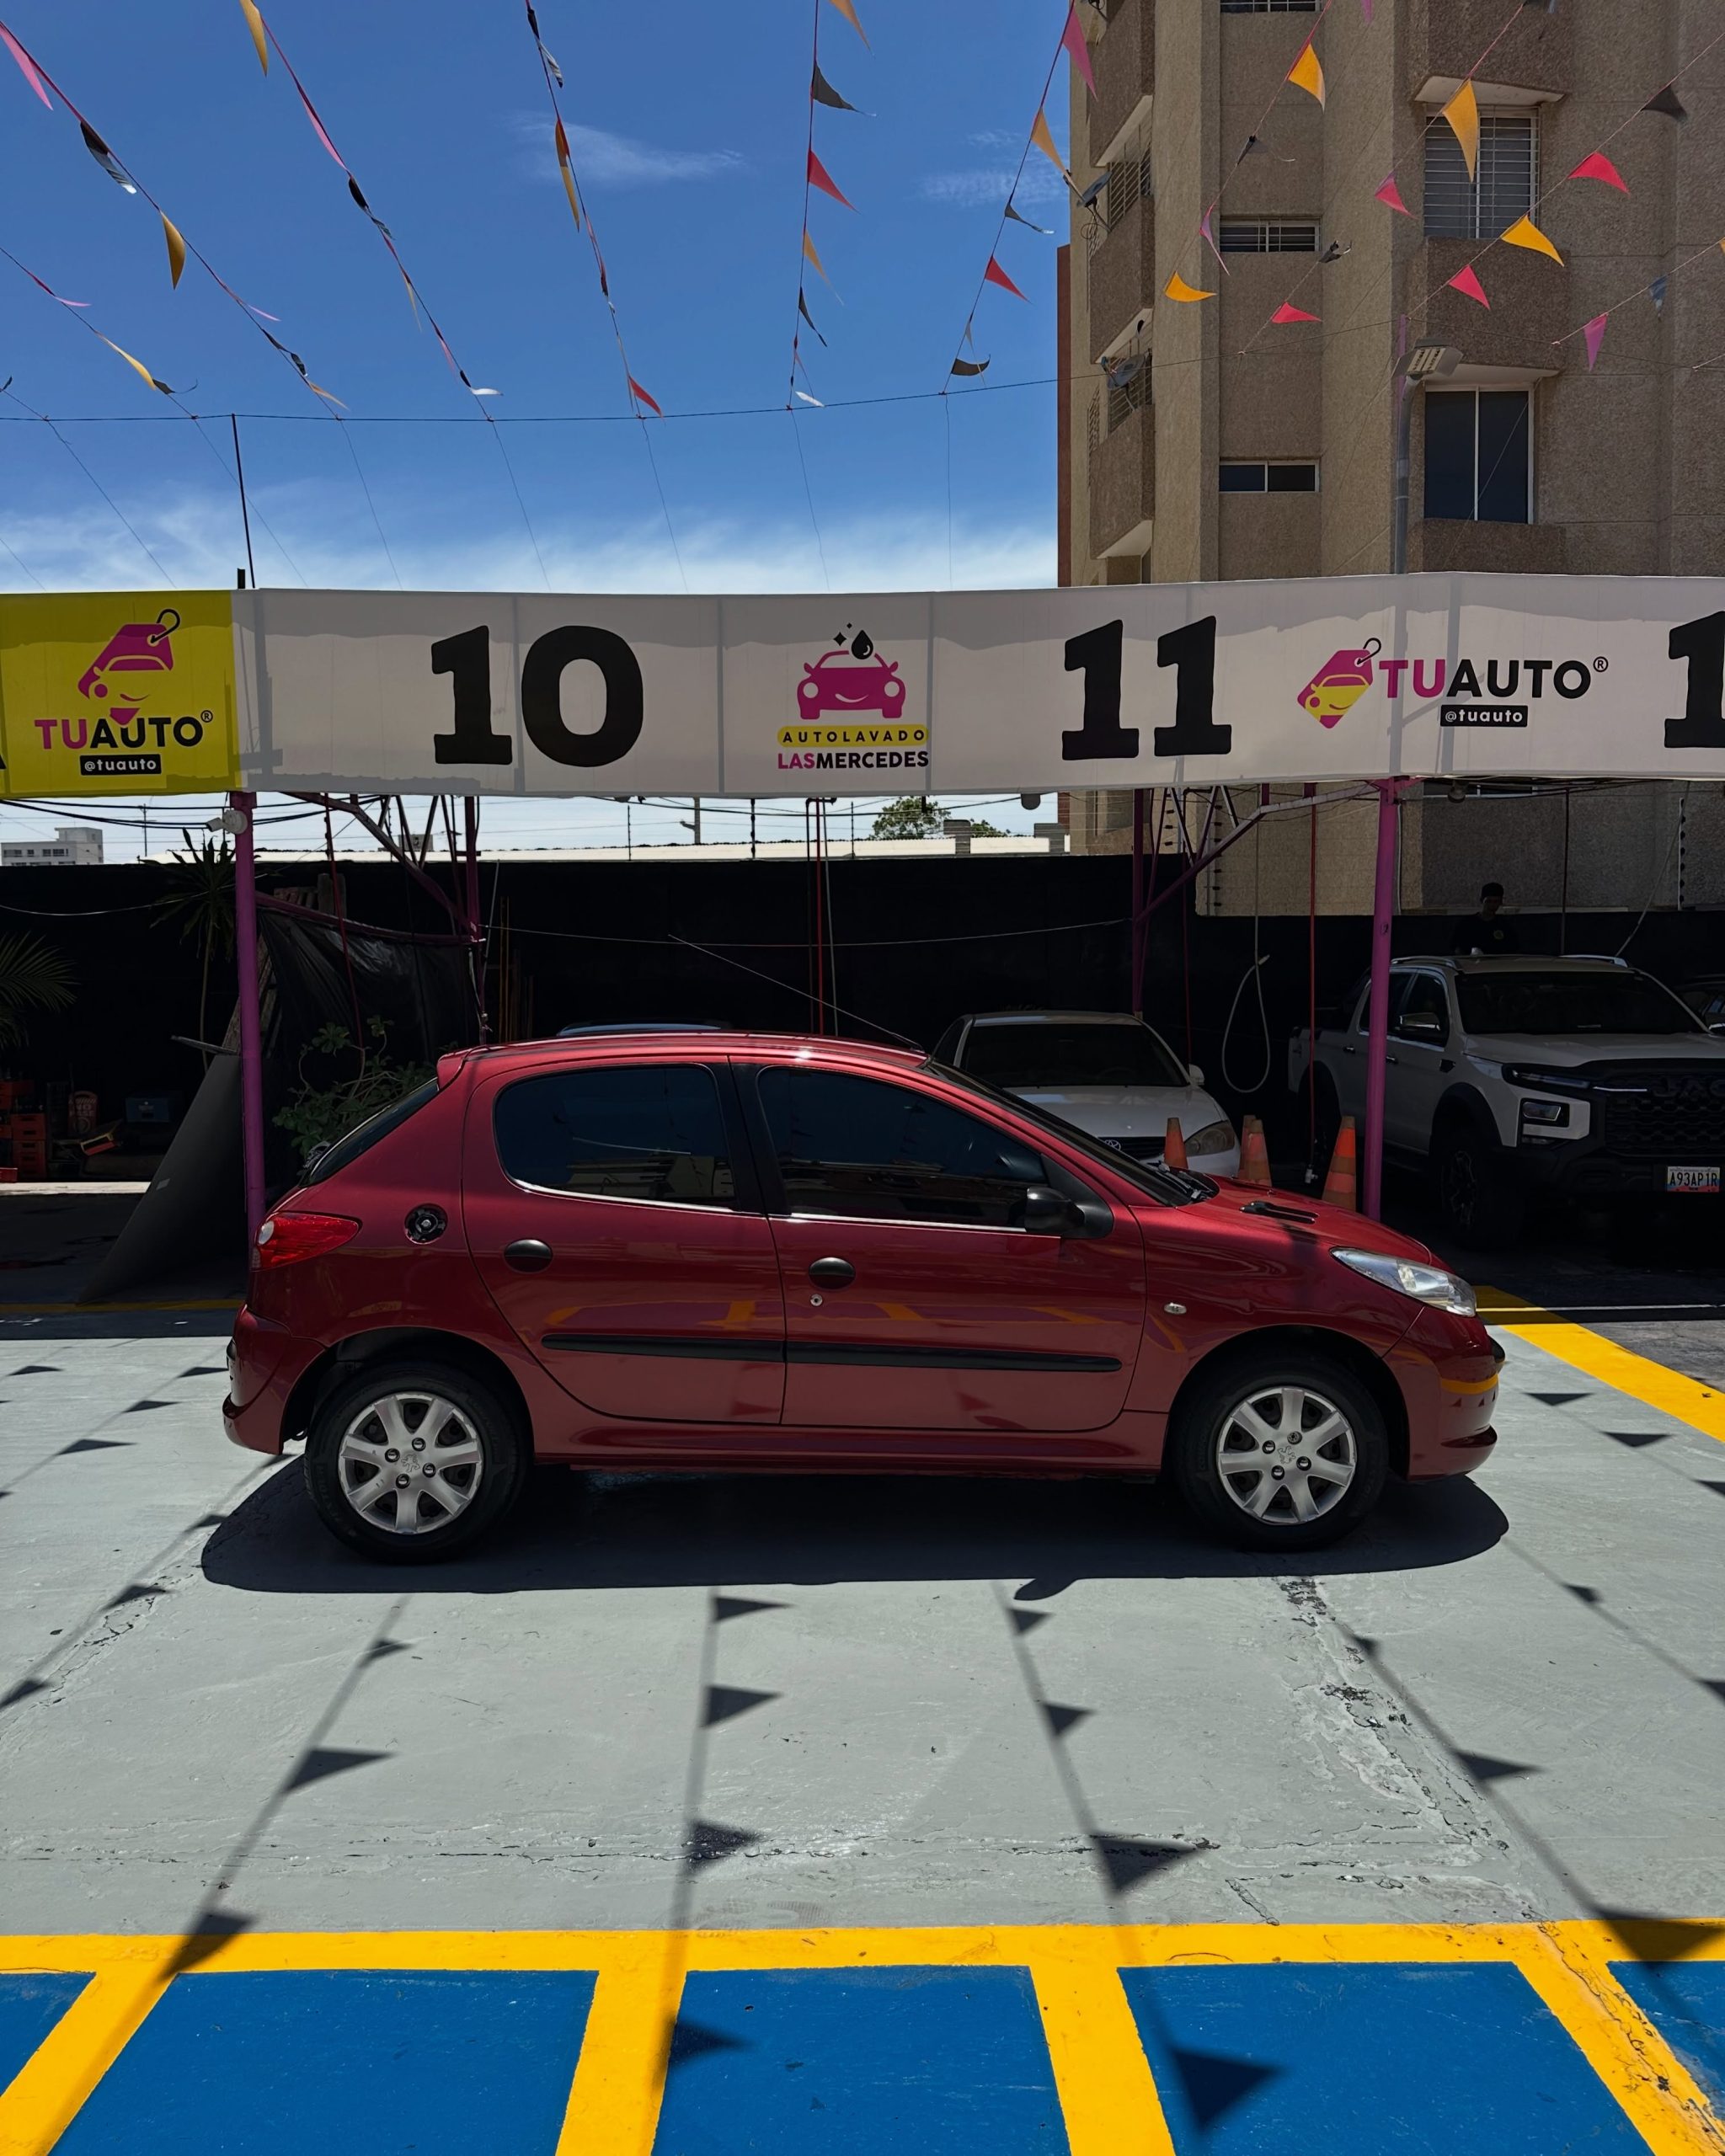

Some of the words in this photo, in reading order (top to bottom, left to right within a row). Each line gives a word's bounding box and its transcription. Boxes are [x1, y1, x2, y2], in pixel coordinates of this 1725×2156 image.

[1062, 616, 1231, 760] 11
[431, 626, 643, 767] 10
[1445, 709, 1523, 723] @tuauto
[782, 729, 925, 743] AUTOLAVADO
[84, 759, 158, 772] @tuauto
[1670, 1171, 1718, 1186] A93AP1R
